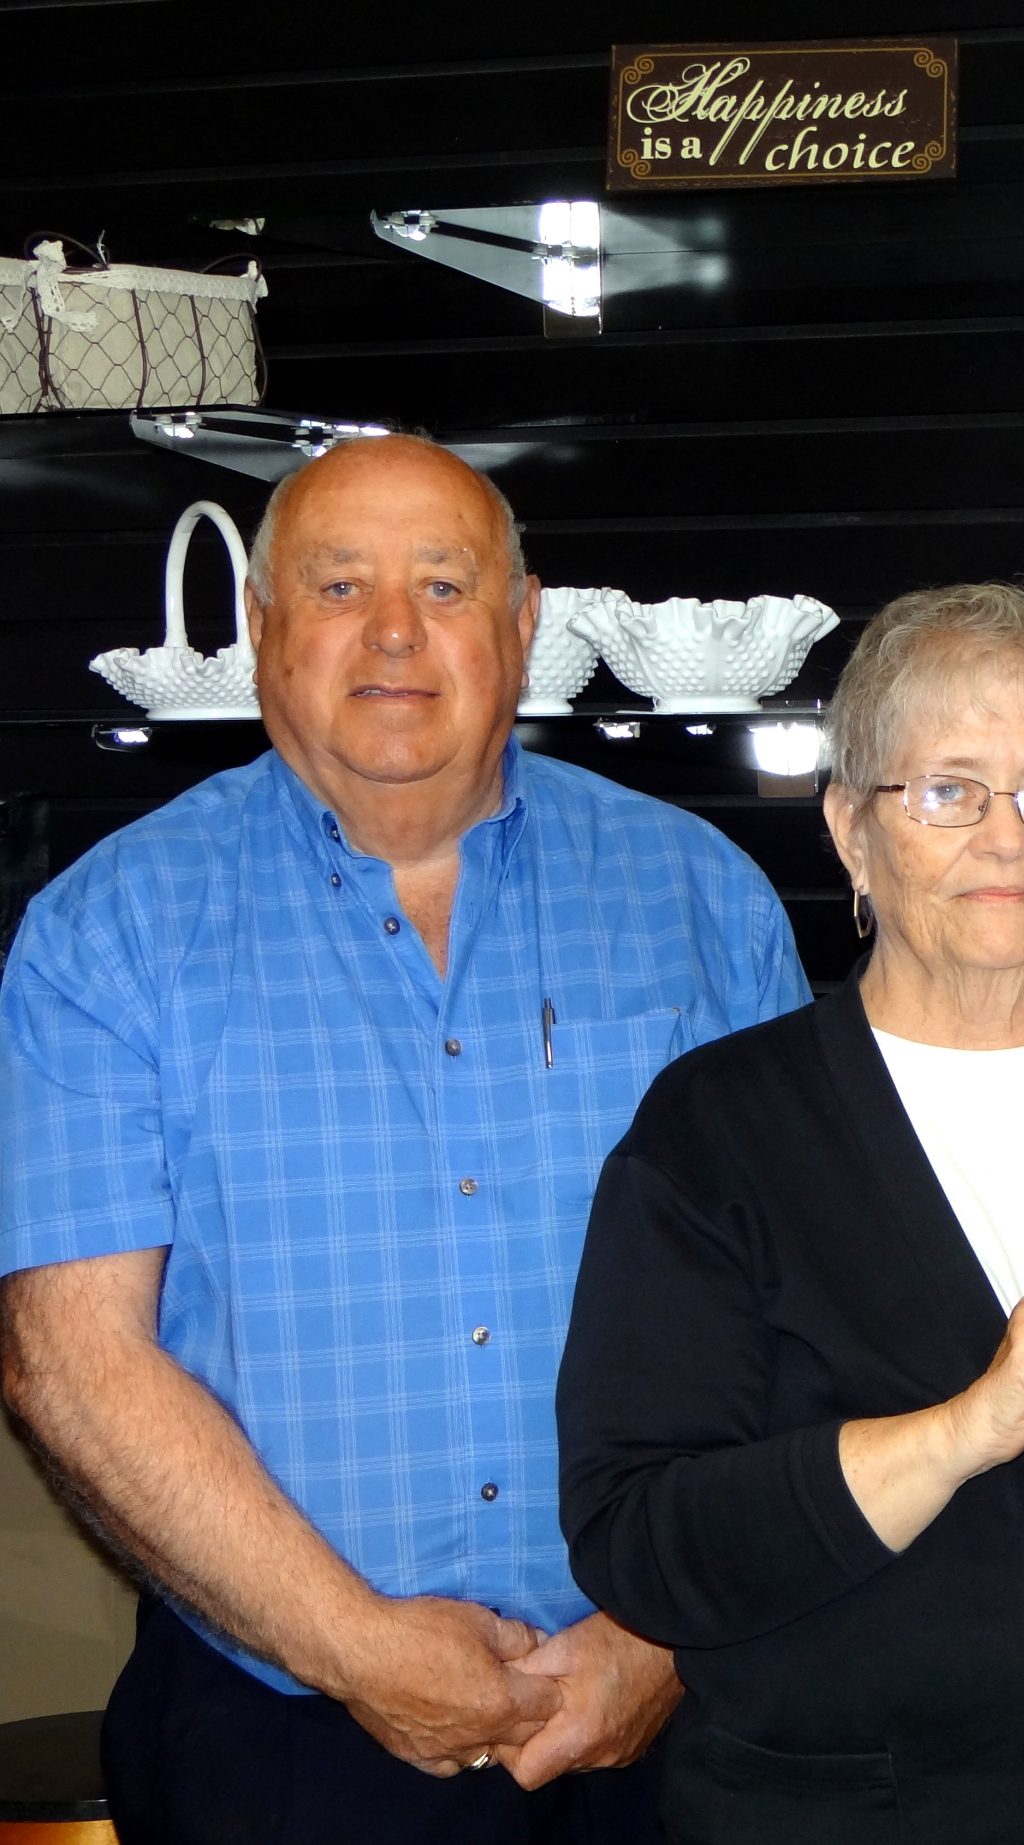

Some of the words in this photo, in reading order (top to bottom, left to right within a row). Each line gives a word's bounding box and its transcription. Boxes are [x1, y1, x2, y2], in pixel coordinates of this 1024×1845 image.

[626, 57, 908, 166] Happiness
[640, 127, 672, 160] is
[680, 136, 703, 159] a
[765, 126, 915, 171] choice
